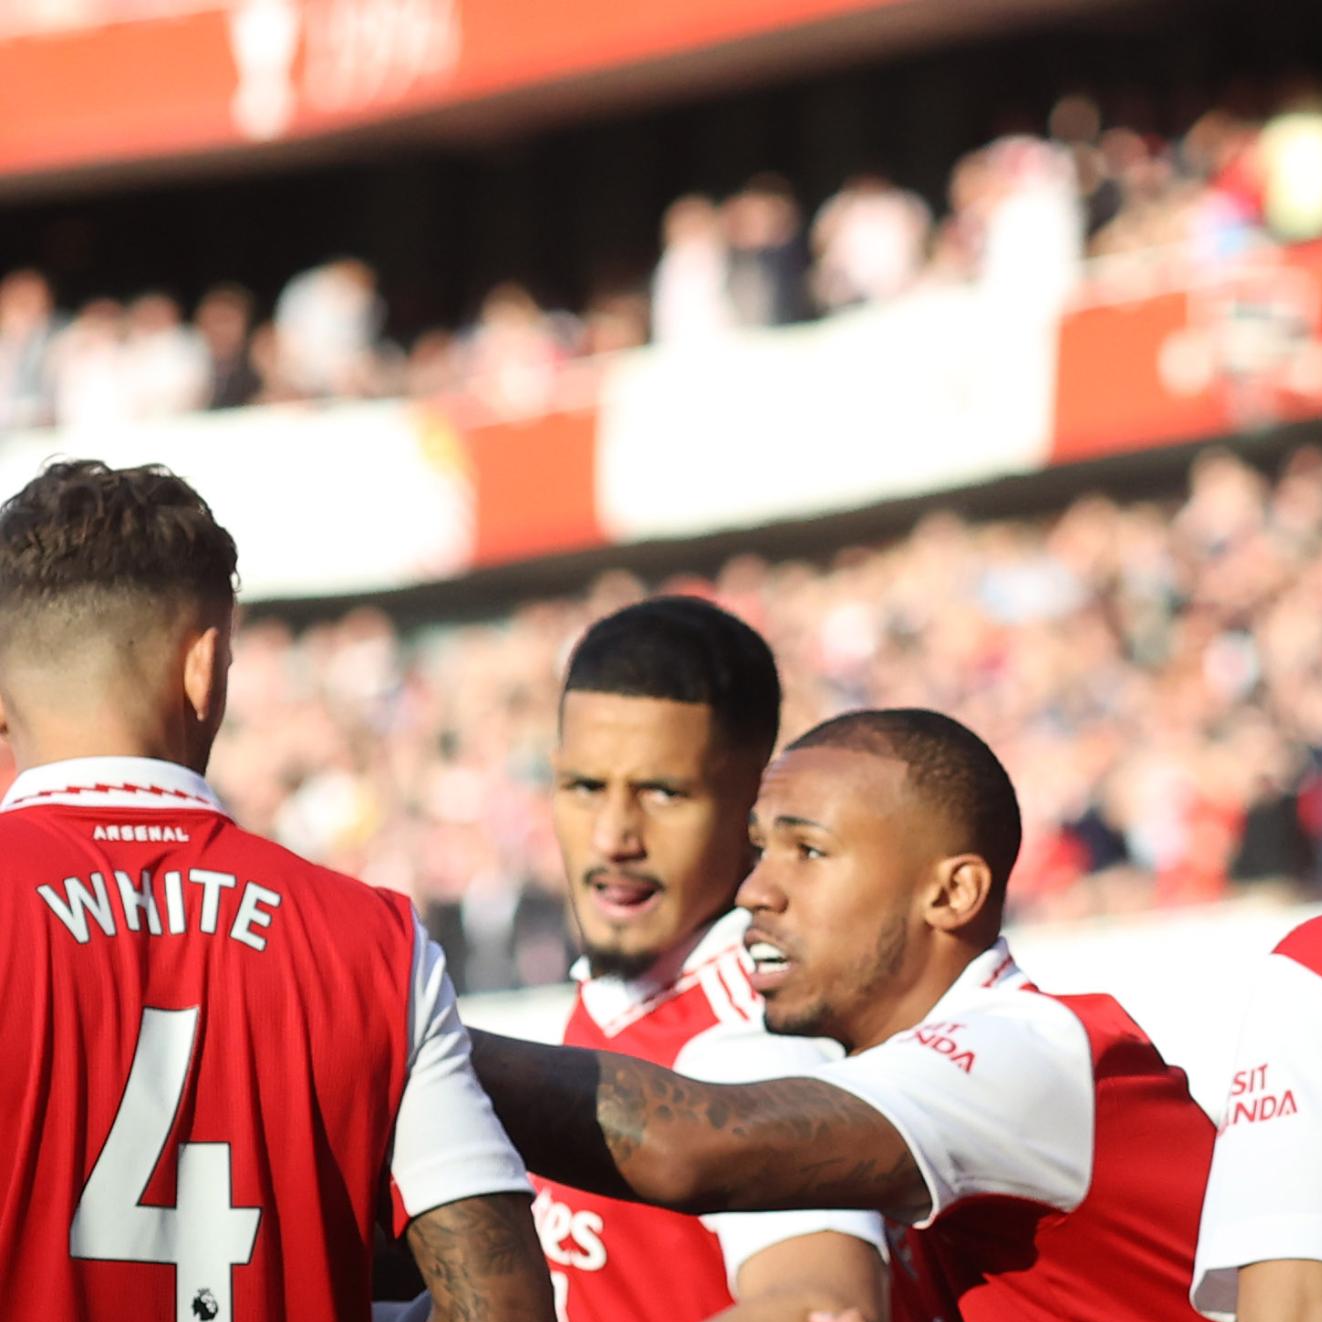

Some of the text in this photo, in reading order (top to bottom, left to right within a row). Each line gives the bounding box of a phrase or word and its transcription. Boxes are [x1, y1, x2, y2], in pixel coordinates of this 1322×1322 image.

[93, 824, 190, 842] ARSENAL
[36, 869, 281, 952] WHITE
[1231, 1063, 1268, 1097] SIT
[1224, 1089, 1298, 1130] NDA
